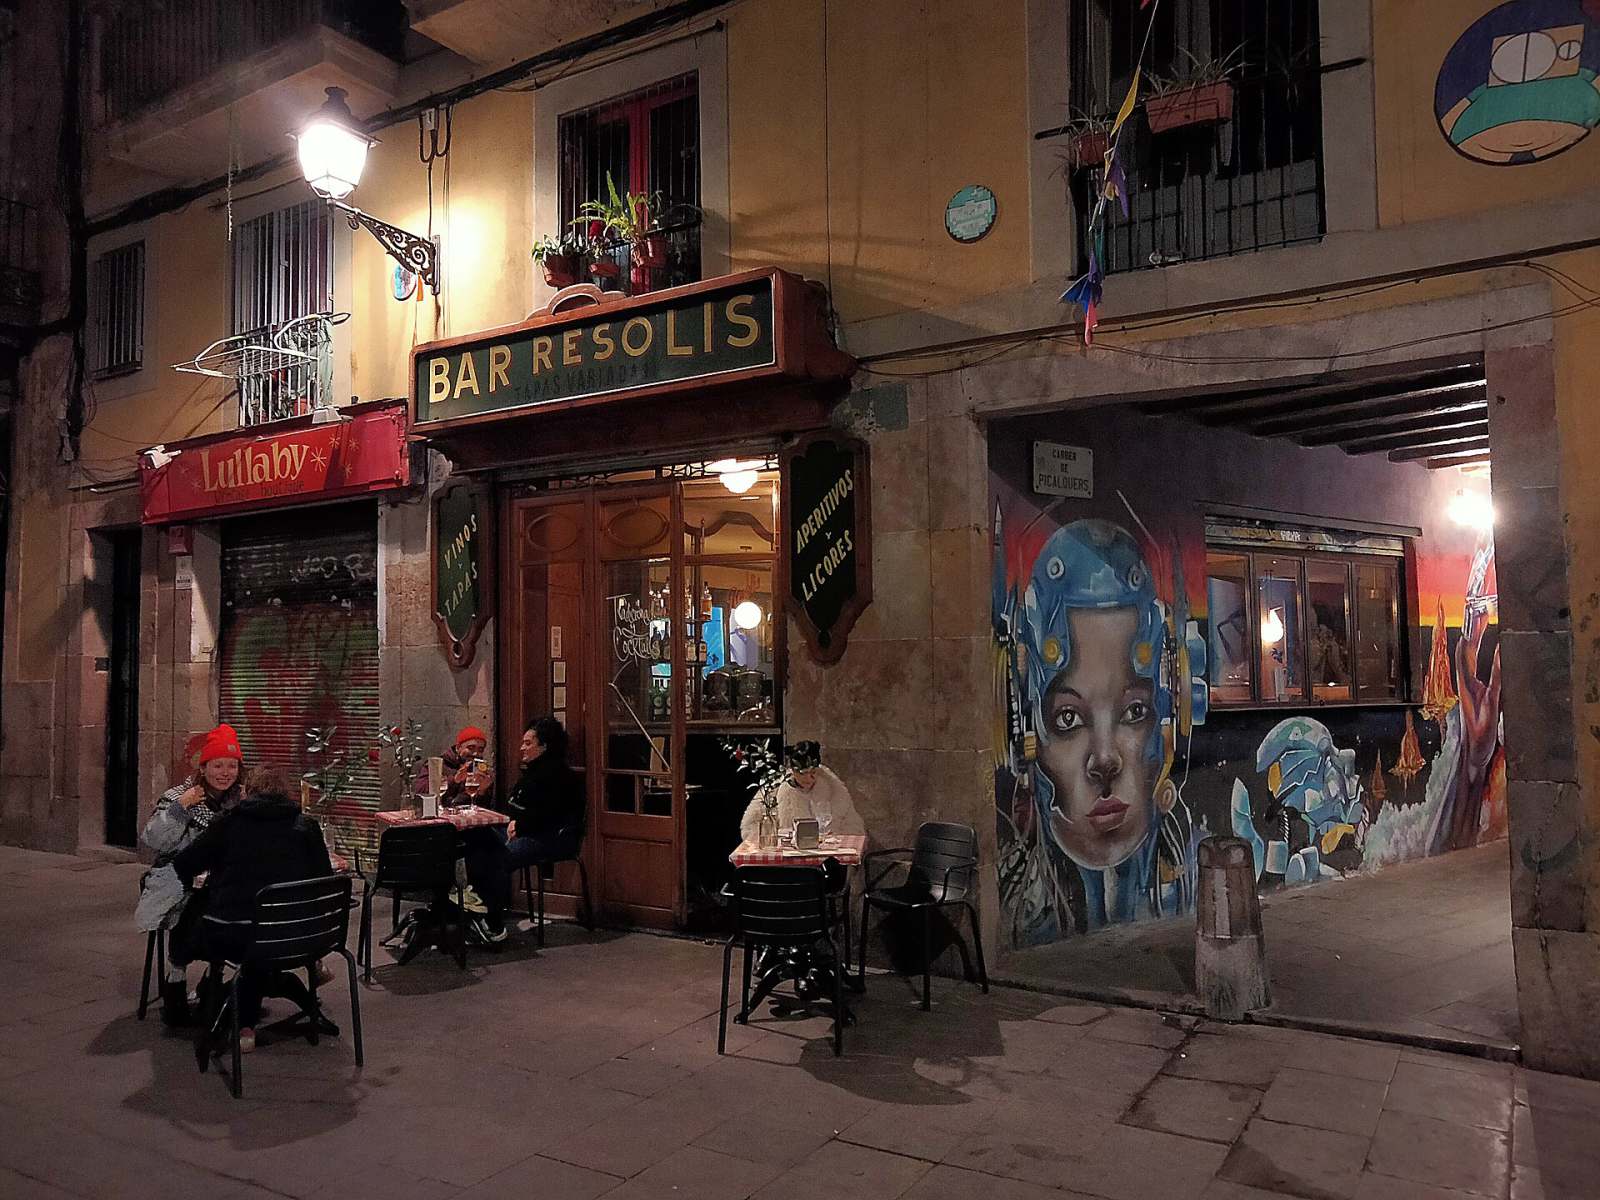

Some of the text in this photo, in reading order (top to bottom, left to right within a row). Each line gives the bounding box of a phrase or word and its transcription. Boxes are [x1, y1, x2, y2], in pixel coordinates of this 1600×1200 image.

[428, 294, 763, 404] BAR RESOLIS
[200, 441, 310, 492] Lullaby
[796, 469, 854, 554] APERITIVOS
[825, 531, 832, 540] Y
[444, 514, 477, 569] VINOS
[802, 529, 853, 601] LICORES
[444, 562, 478, 617] TAPAS
